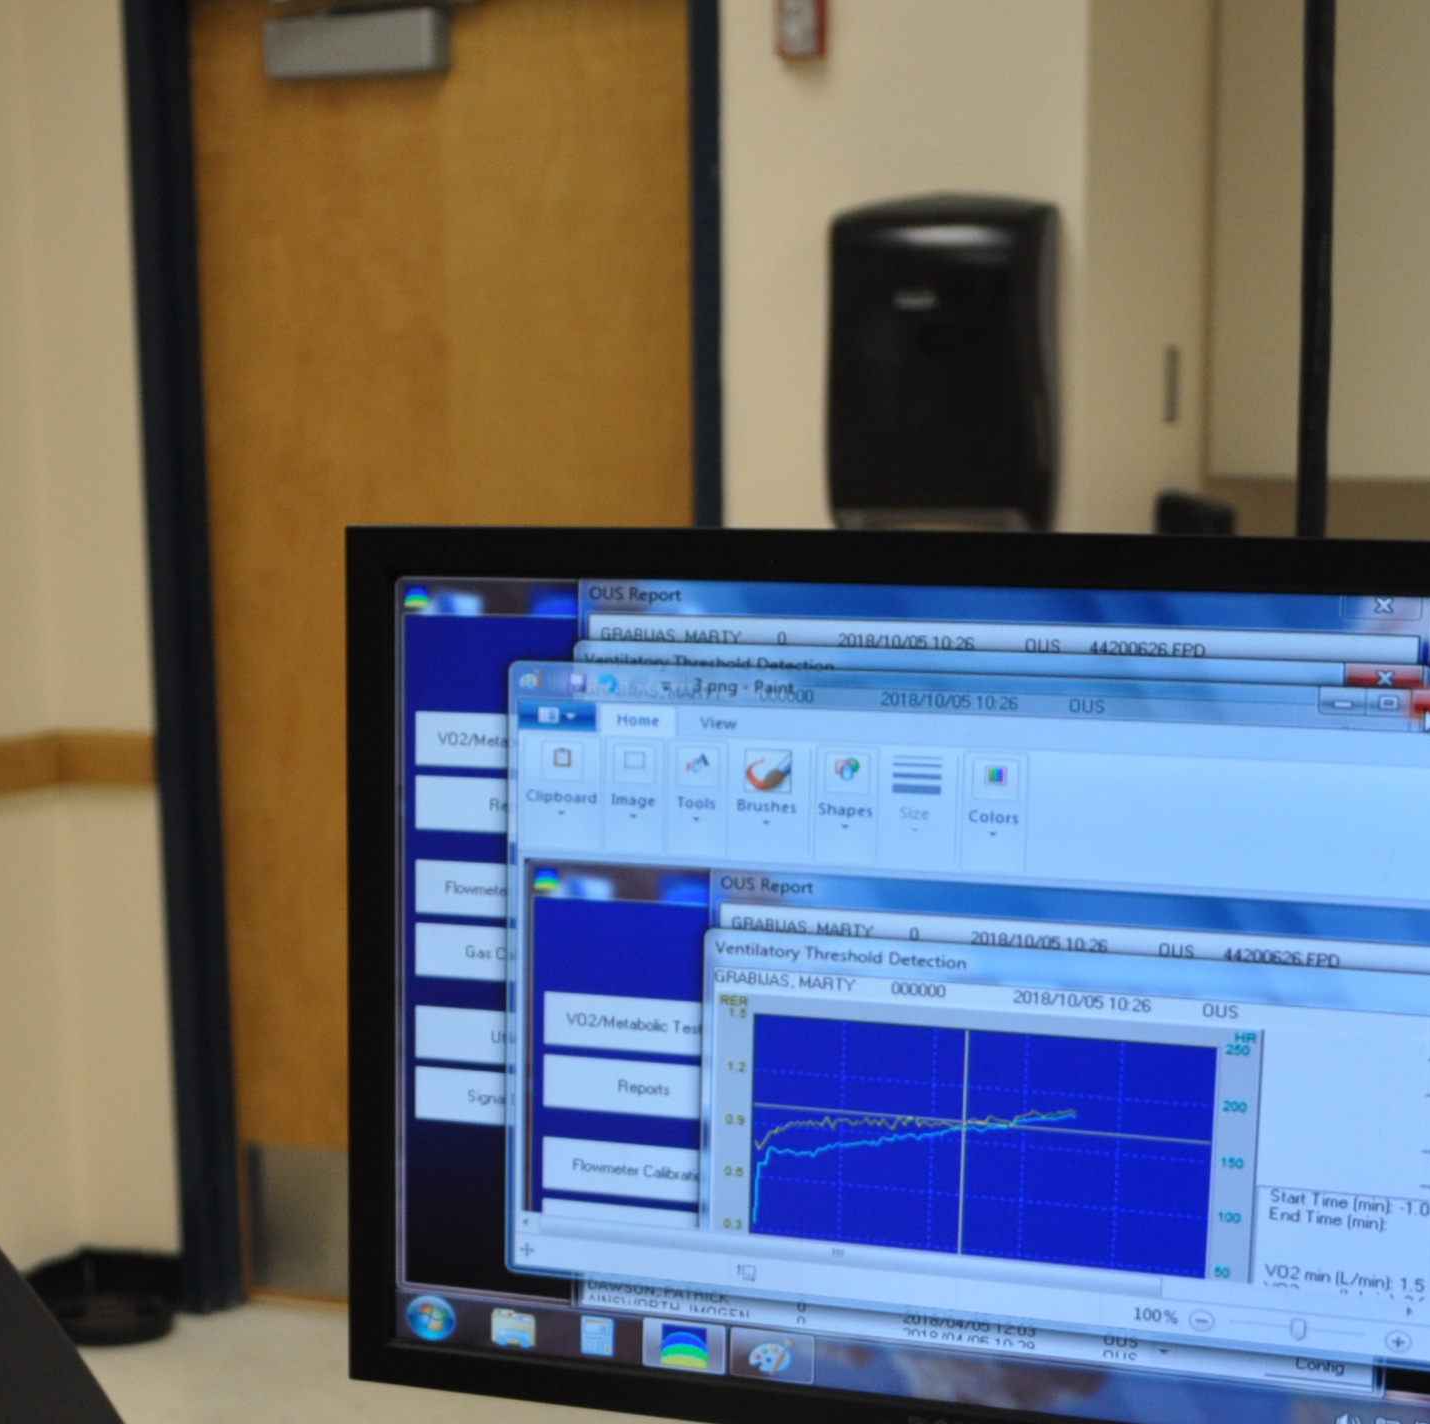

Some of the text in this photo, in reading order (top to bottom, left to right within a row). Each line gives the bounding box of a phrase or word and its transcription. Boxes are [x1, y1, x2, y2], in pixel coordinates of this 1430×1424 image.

[589, 586, 681, 605] OUS Report
[838, 633, 927, 649] 2018/10/05
[933, 636, 975, 650] 10:26
[1025, 638, 1061, 654] OUS
[755, 679, 795, 695] Paint
[1069, 699, 1105, 713] OUS
[617, 714, 737, 730] Home View
[526, 789, 597, 806] Clipboard
[611, 793, 655, 809] Image
[677, 796, 716, 810] Tools
[736, 797, 797, 814] Brushes
[818, 803, 873, 819] Shapes
[899, 807, 929, 820] Size
[969, 810, 1019, 825] Colors
[721, 876, 814, 895] OUS Report
[715, 941, 966, 970] Ventilatory Threshold Detection
[1159, 943, 1194, 959] OUS
[800, 976, 855, 992] MARTY
[1013, 990, 1104, 1010] 2018/10/05
[1109, 995, 1151, 1013] 10:26
[1203, 1002, 1238, 1019] OUS
[567, 1012, 668, 1033] VO2/Metabolic
[1234, 1032, 1257, 1043] HR
[1225, 1044, 1250, 1056] 250
[618, 1079, 670, 1097] Reports
[1223, 1101, 1247, 1113] 200
[573, 1158, 639, 1176] Flowmeter
[1220, 1157, 1244, 1169] 150
[1270, 1188, 1306, 1202] Start
[1312, 1192, 1348, 1209] Time
[1217, 1212, 1241, 1224] 100
[1269, 1206, 1300, 1222] End
[1306, 1209, 1342, 1226] Time
[1213, 1266, 1230, 1278] 50
[1265, 1263, 1301, 1281] VO2
[1304, 1268, 1331, 1284] min
[1400, 1277, 1425, 1293] 1.5
[663, 1285, 730, 1304] PATRICK
[1134, 1306, 1179, 1325] 100%
